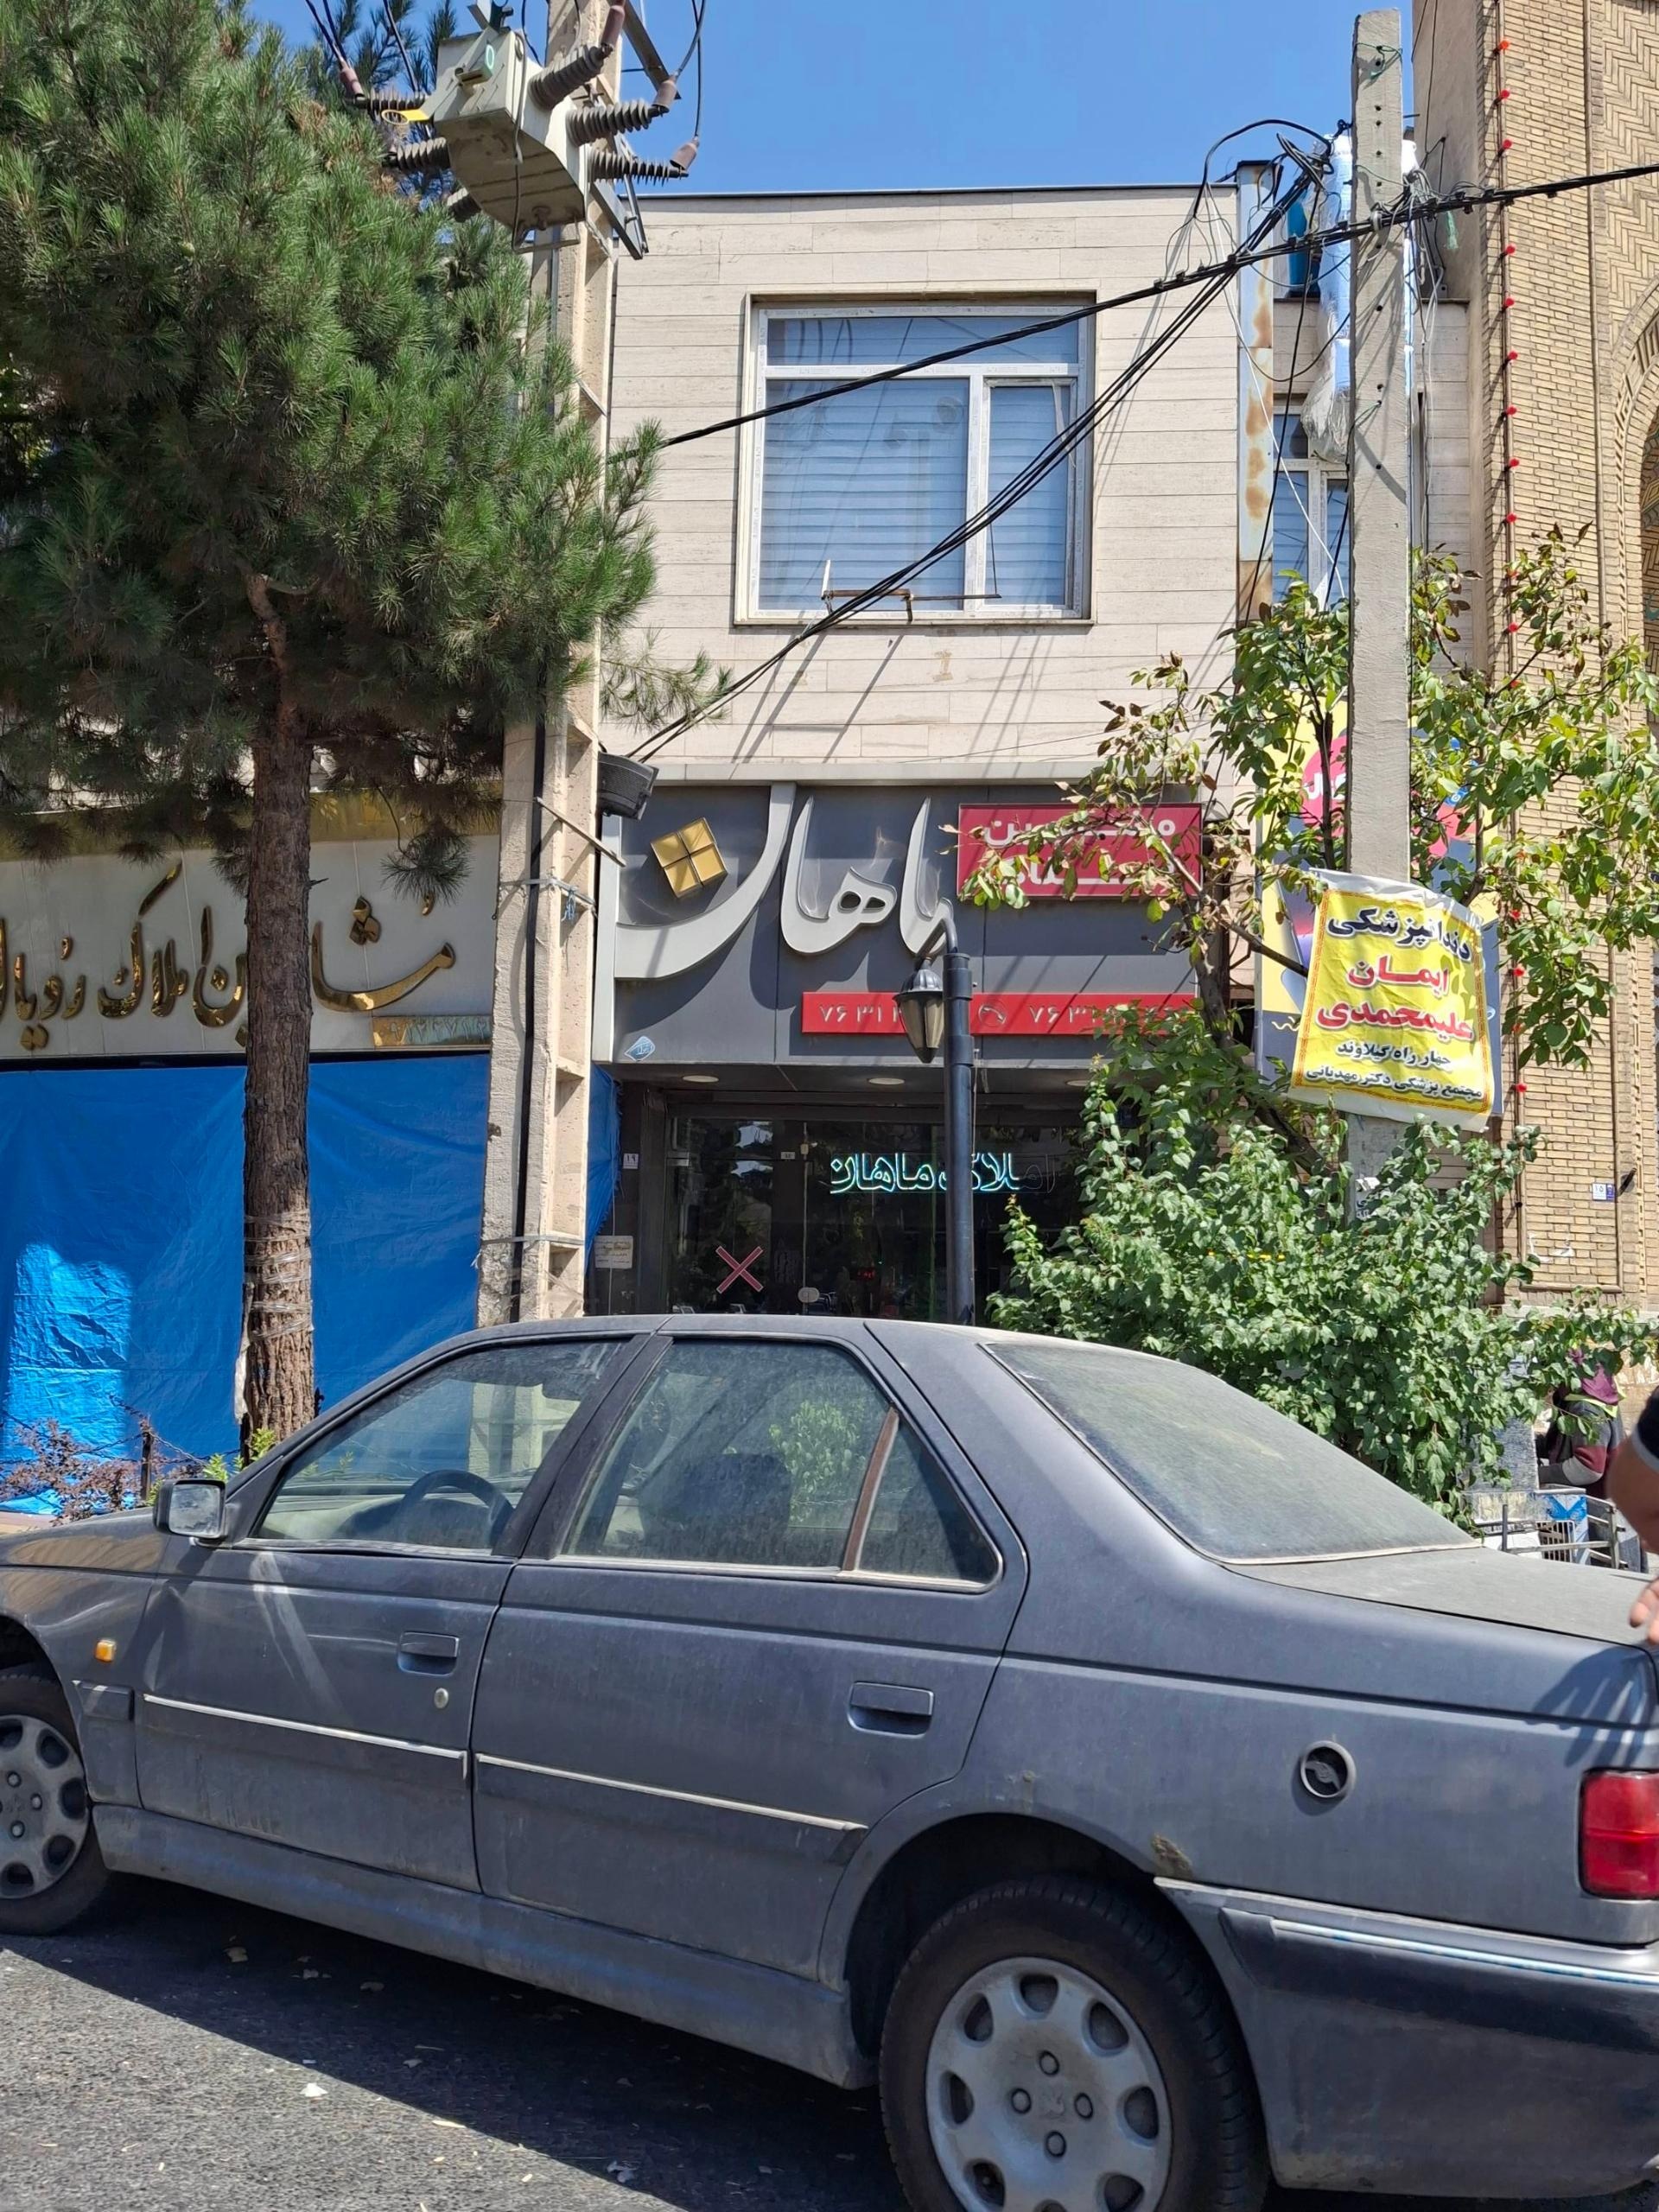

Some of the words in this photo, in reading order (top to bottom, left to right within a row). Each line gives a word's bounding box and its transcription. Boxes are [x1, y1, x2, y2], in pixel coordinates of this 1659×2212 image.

[1348, 955, 1450, 995] ایمان
[1360, 1071, 1391, 1085] دکتر
[1394, 1077, 1440, 1095] پزشکی
[1441, 1084, 1483, 1100] مجتمع
[830, 1153, 937, 1193] ماهان
